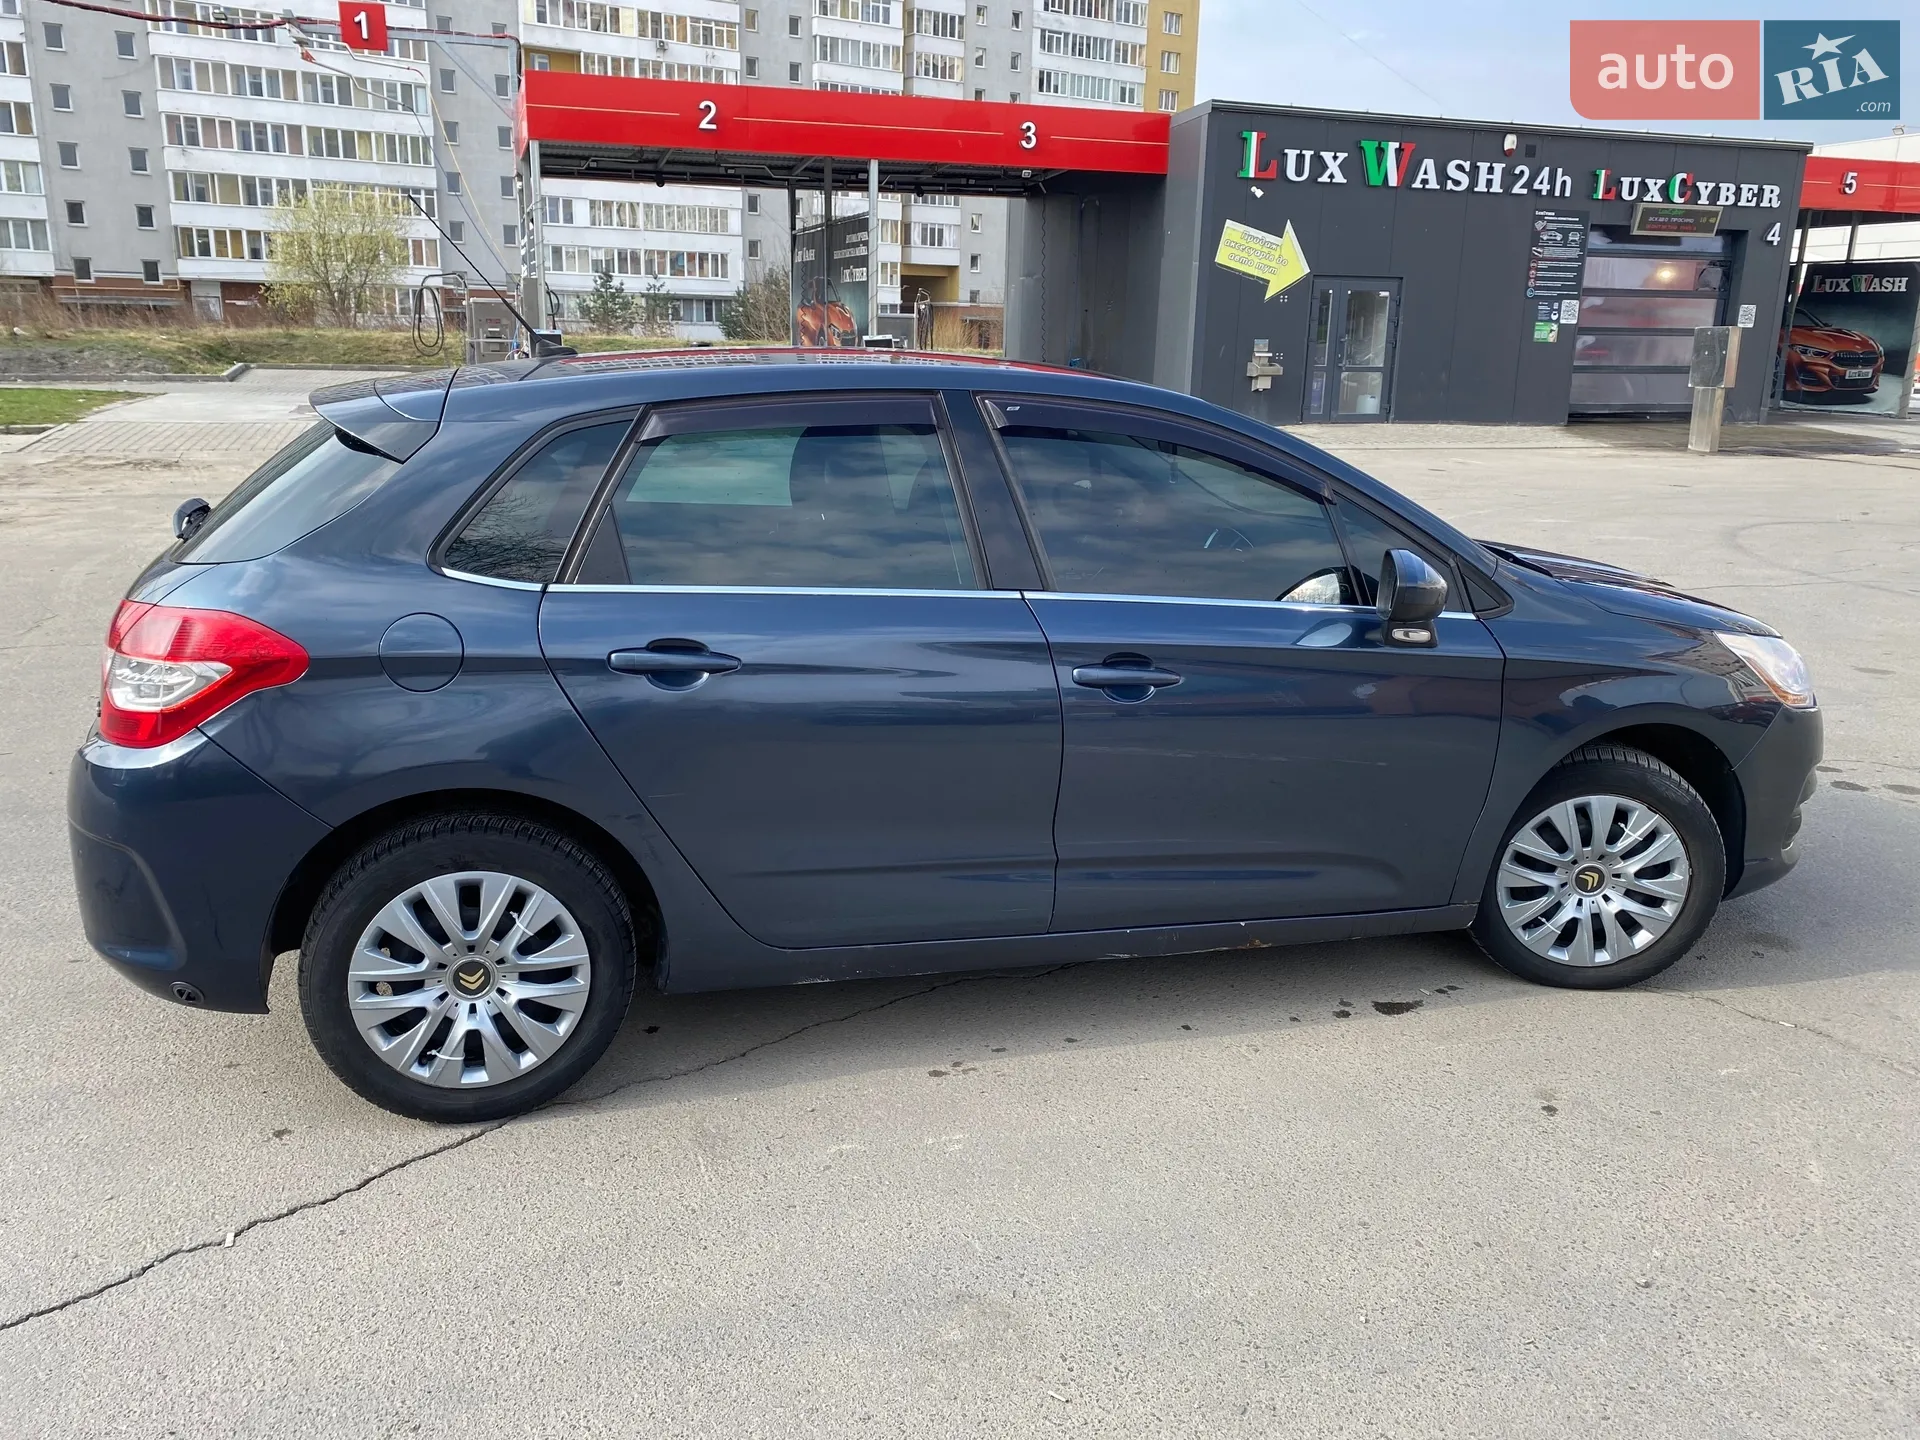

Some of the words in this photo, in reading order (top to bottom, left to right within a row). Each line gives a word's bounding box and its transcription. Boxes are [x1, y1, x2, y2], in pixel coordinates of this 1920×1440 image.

[353, 11, 369, 40] 1
[698, 100, 717, 130] 2
[1019, 121, 1037, 149] 3
[1511, 165, 1572, 197] 24h
[1843, 172, 1858, 194] 5
[1240, 230, 1280, 251] Продаж
[1766, 222, 1781, 246] 4
[1224, 239, 1275, 261] аксесуарів
[1276, 254, 1288, 266] до
[1228, 252, 1254, 266] авто
[1255, 261, 1278, 275] тут
